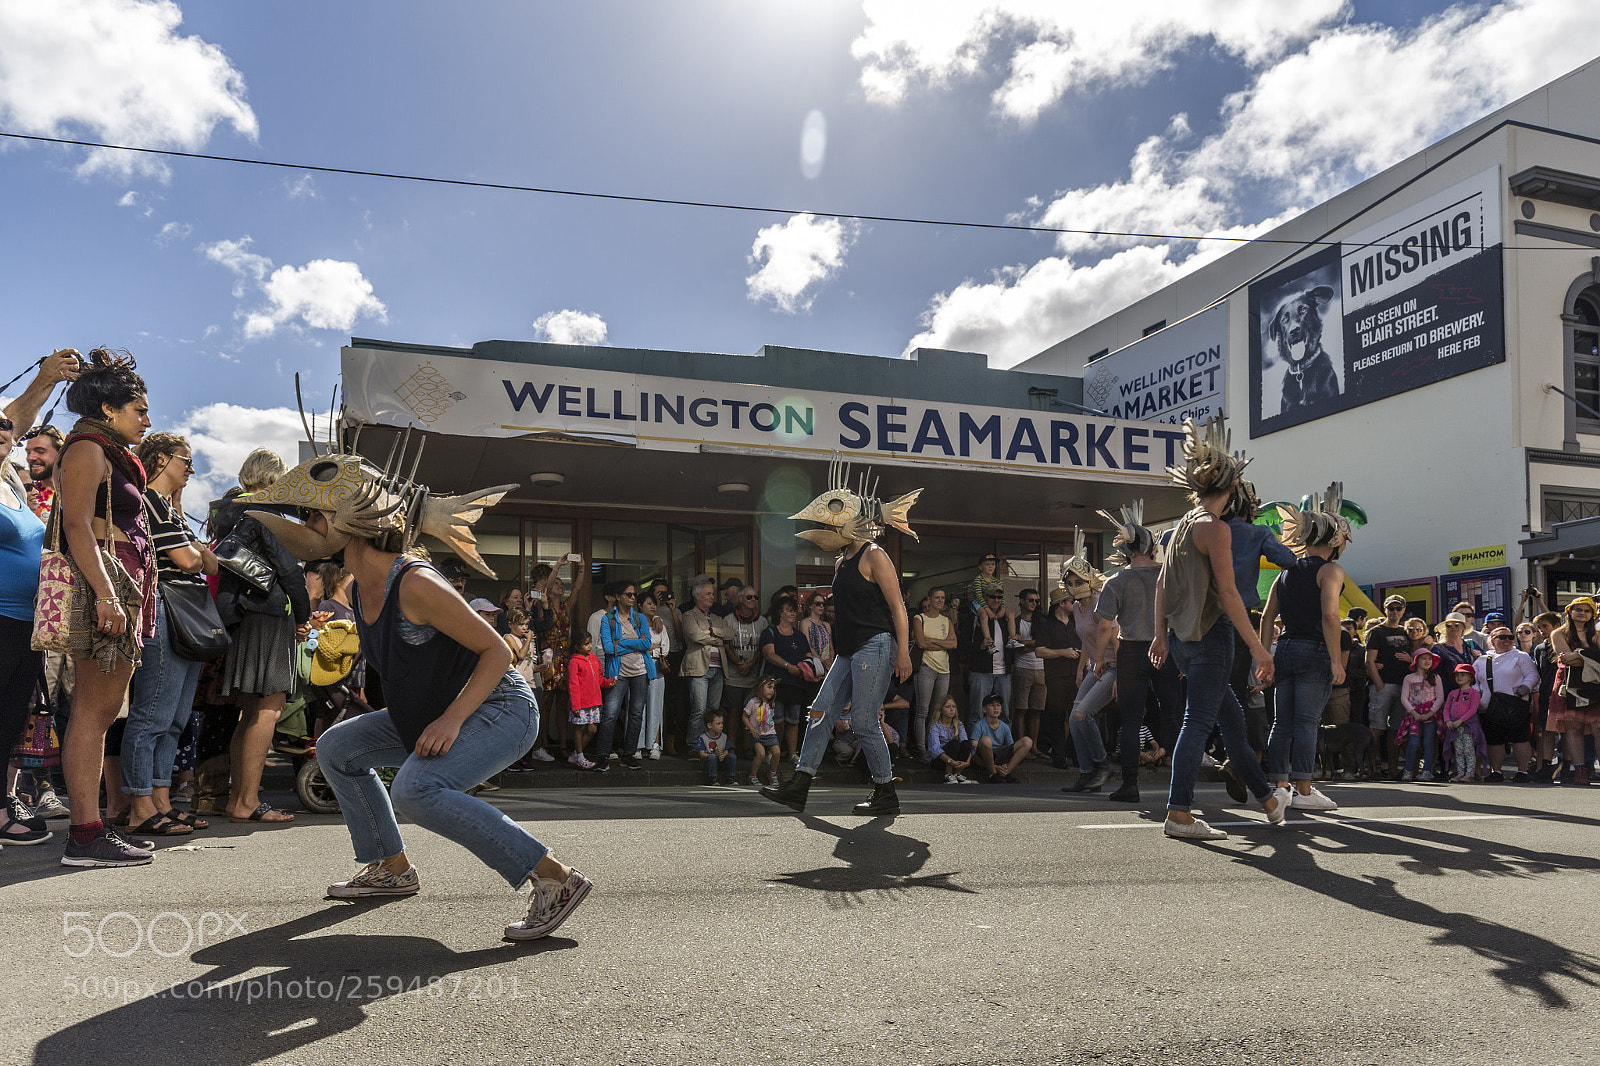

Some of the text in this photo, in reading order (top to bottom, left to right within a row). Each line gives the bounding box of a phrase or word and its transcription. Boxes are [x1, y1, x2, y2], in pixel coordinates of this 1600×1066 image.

[1349, 211, 1472, 298] MISSING
[1356, 298, 1417, 333] LAST SEEN ON
[1361, 305, 1439, 348] BLAIR STREET.
[1353, 310, 1485, 372] PLEASE RETURN TO BREWERY.
[1437, 334, 1480, 360] HERE FEB
[1119, 344, 1221, 397] WELLINGTON
[501, 379, 1187, 474] WELLINGTON SEAMARKET
[1180, 405, 1210, 422] Chips
[1461, 549, 1504, 561] PHANTOM
